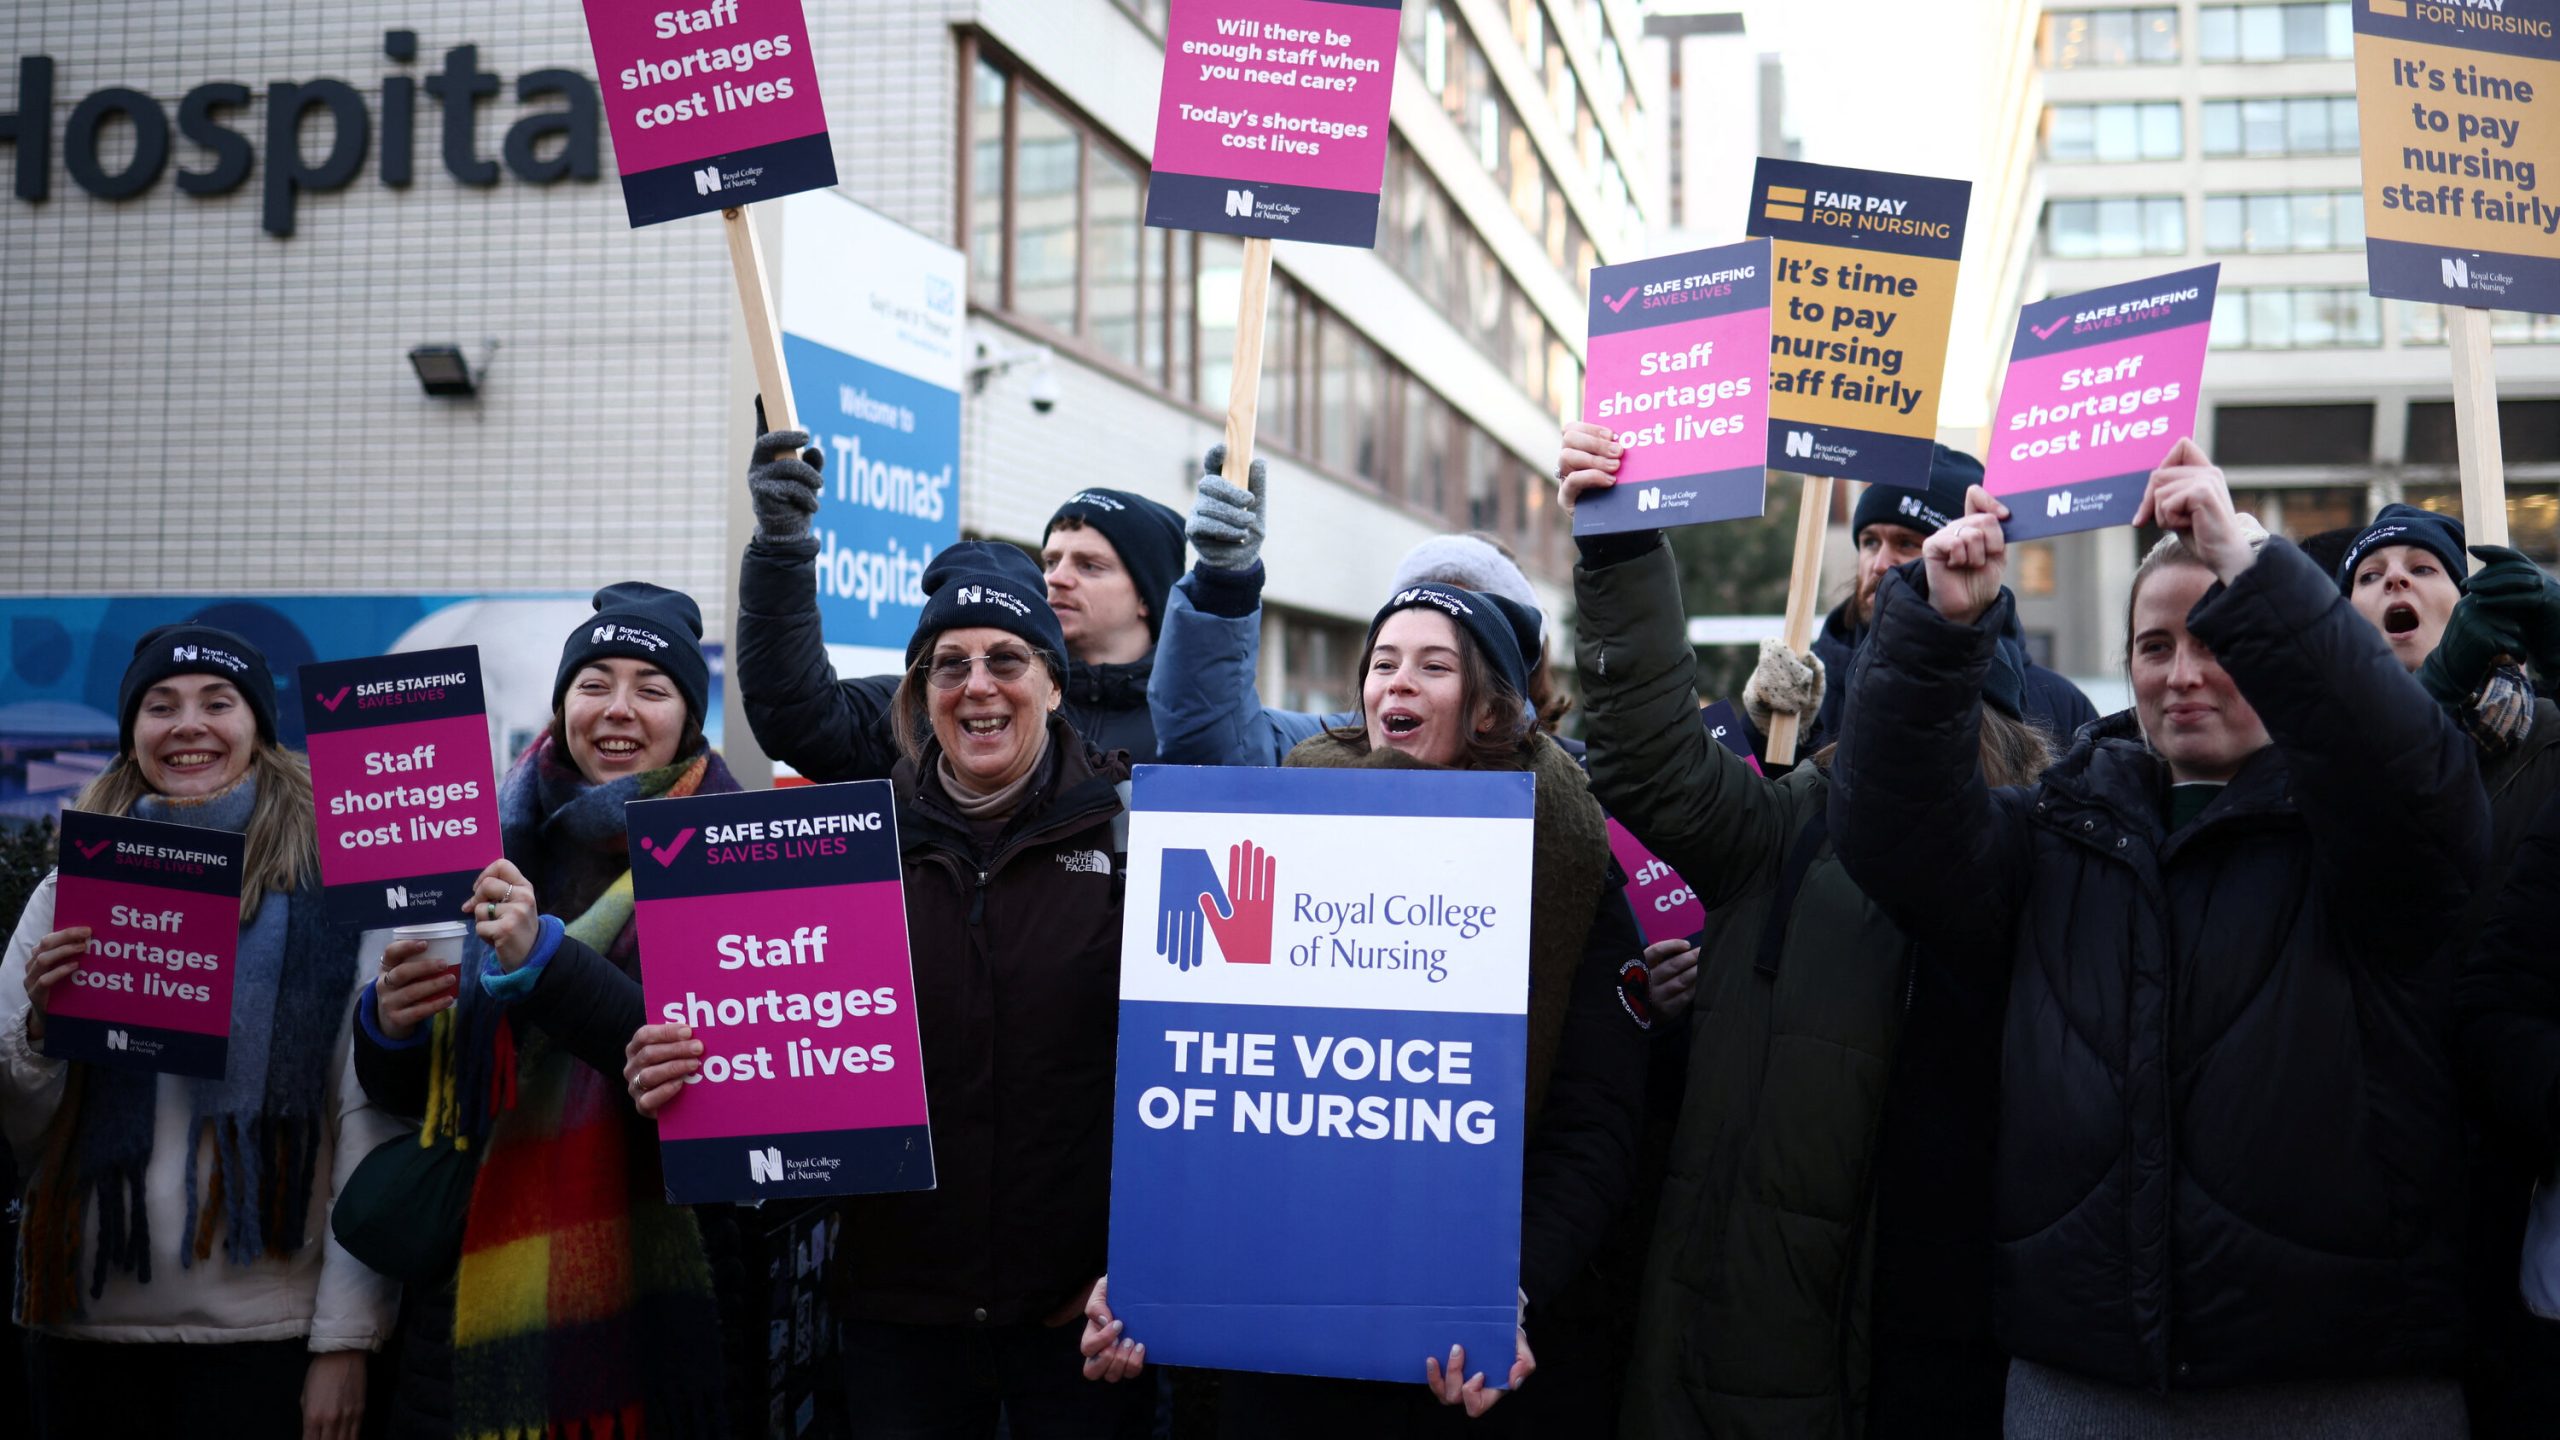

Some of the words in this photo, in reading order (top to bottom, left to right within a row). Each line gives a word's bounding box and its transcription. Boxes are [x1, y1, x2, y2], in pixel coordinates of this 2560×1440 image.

[654, 0, 738, 39] Staff
[1217, 18, 1259, 38] Will
[1264, 23, 1320, 44] there
[1325, 29, 1351, 47] be
[2416, 5, 2455, 24] FOR
[2462, 11, 2552, 38] NURSING
[620, 35, 791, 90] shortages
[1183, 41, 1262, 62] enough
[1267, 48, 1317, 66] staff
[1320, 54, 1380, 72] when
[1200, 63, 1239, 81] you
[1245, 67, 1296, 86] need
[1301, 74, 1357, 91] care?
[2394, 58, 2445, 92] It’s
[2453, 65, 2533, 103] time
[636, 92, 709, 129] cost
[713, 77, 794, 112] lives
[0, 29, 601, 238] Hospita
[1179, 104, 1258, 129] Today’s
[1262, 112, 1368, 139] shortages
[2412, 103, 2449, 132] to
[2458, 113, 2519, 148] pay
[1222, 133, 1267, 150] cost
[1271, 134, 1319, 155] lives
[722, 171, 740, 181] Royal
[740, 167, 763, 178] College
[732, 178, 756, 190] Nursing
[2403, 147, 2535, 191] nursing
[1254, 210, 1263, 218] of
[1263, 211, 1289, 223] Nursing
[1256, 201, 1275, 212] Royal
[1276, 203, 1300, 214] College
[1814, 190, 1861, 211] FAIR
[1865, 197, 1907, 215] PAY
[2383, 184, 2464, 217] staff
[2471, 190, 2560, 234] fairly
[1812, 209, 1852, 228] FOR
[1858, 214, 1950, 239] NURSING
[1643, 280, 1681, 297] SAFE
[1684, 266, 1754, 290] STAFFING
[1777, 257, 1829, 287] It’s
[1838, 263, 1917, 298] time
[2471, 271, 2488, 282] Royal
[2489, 273, 2513, 284] College
[2471, 281, 2479, 289] of
[2480, 281, 2505, 294] Nursing
[1642, 292, 1688, 310] SAVES
[1692, 283, 1732, 301] LIVES
[2075, 305, 2116, 324] SAFE
[2120, 288, 2198, 314] STAFFING
[1789, 297, 1824, 322] to
[1832, 305, 1897, 338] pay
[2073, 317, 2122, 334] SAVES
[2127, 305, 2171, 323] LIVES
[1640, 342, 1713, 376] Staff
[1771, 334, 1903, 376] nursing
[2060, 355, 2143, 391] Staff
[1599, 376, 1751, 417] shortages
[1768, 369, 1824, 396] aff
[1831, 373, 1923, 416] fairly
[2010, 383, 2180, 431] shortages
[839, 384, 898, 426] Welcome
[900, 405, 915, 433] to
[1613, 423, 1665, 450] ost
[1674, 414, 1744, 442] lives
[2010, 432, 2080, 461] cost
[2090, 416, 2169, 447] lives
[1813, 452, 1821, 460] of
[1822, 452, 1846, 465] Nursing
[1815, 443, 1832, 453] Royal
[1833, 445, 1857, 457] College
[1660, 500, 1668, 508] of
[1669, 498, 1689, 508] Nursing
[1662, 492, 1677, 500] Royal
[1678, 491, 1698, 500] College
[985, 588, 1007, 597] Royal
[1008, 595, 1031, 614] College
[995, 598, 1022, 616] Nursing
[1428, 596, 1460, 615] Nursing
[619, 626, 641, 635] Royal
[642, 630, 669, 648] College
[626, 635, 657, 652] Nursing
[202, 647, 223, 656] Royal
[224, 652, 248, 670] College
[212, 656, 239, 672] Nursing
[357, 681, 394, 696] SAFE
[397, 672, 466, 692] STAFFING
[357, 693, 402, 710] SAVES
[407, 688, 446, 703] LIVES
[365, 744, 436, 775] Staff
[330, 780, 479, 815] shortages
[340, 822, 402, 849] cost
[410, 815, 477, 842] lives
[705, 822, 764, 844] SAFE
[769, 812, 882, 839] STAFFING
[115, 854, 160, 871] SAVES
[165, 862, 204, 875] LIVES
[117, 842, 154, 857] SAFE
[157, 847, 228, 867] STAFFING
[706, 843, 778, 865] SAVES
[787, 837, 848, 858] LIVES
[1056, 854, 1092, 864] NORTH
[1073, 850, 1093, 858] THE
[1065, 864, 1092, 872] FACE
[418, 897, 436, 906] Nursing
[424, 889, 443, 898] College
[110, 905, 184, 933] Staff
[1293, 892, 1375, 935] Royal
[1384, 894, 1496, 939] College
[84, 935, 219, 971] hortages
[717, 925, 828, 970] Staff
[1289, 936, 1321, 967] of
[1330, 938, 1448, 983] Nursing
[71, 969, 133, 992] cost
[143, 973, 210, 1002] lives
[662, 986, 897, 1029] shortages
[787, 1037, 895, 1079] lives
[1165, 1030, 1276, 1077] THE
[1293, 1034, 1473, 1085] VOICE
[1138, 1086, 1216, 1131] OF
[1233, 1090, 1496, 1145] NURSING
[787, 1158, 809, 1171] Royal
[810, 1156, 841, 1169] College
[787, 1169, 798, 1180] of
[799, 1168, 830, 1182] Nursing
